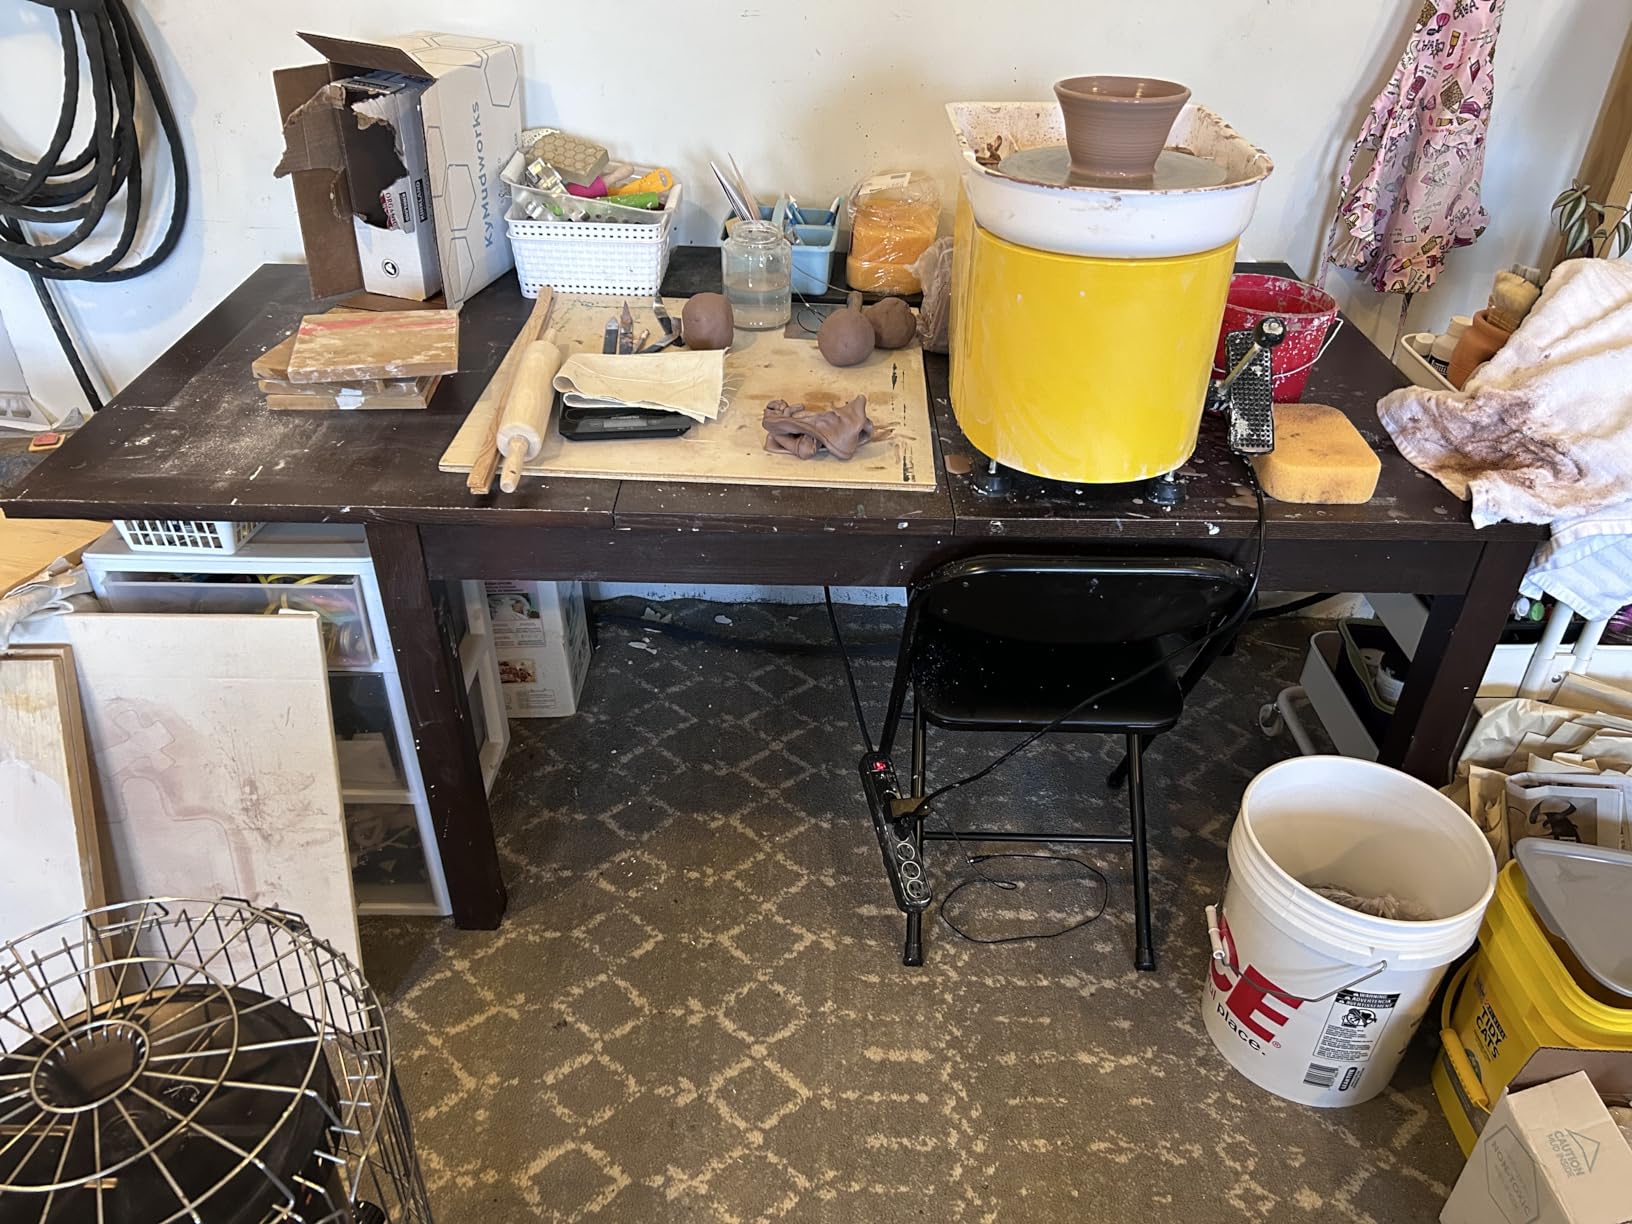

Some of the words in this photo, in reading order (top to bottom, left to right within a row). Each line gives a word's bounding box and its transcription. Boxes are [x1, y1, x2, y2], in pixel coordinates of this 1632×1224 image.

[1216, 1002, 1266, 1056] place.
[1476, 1015, 1500, 1058] CATS
[1481, 1005, 1503, 1045] TIDY
[1546, 1133, 1561, 1153] MUD
[1554, 1130, 1585, 1176] CAUTION
